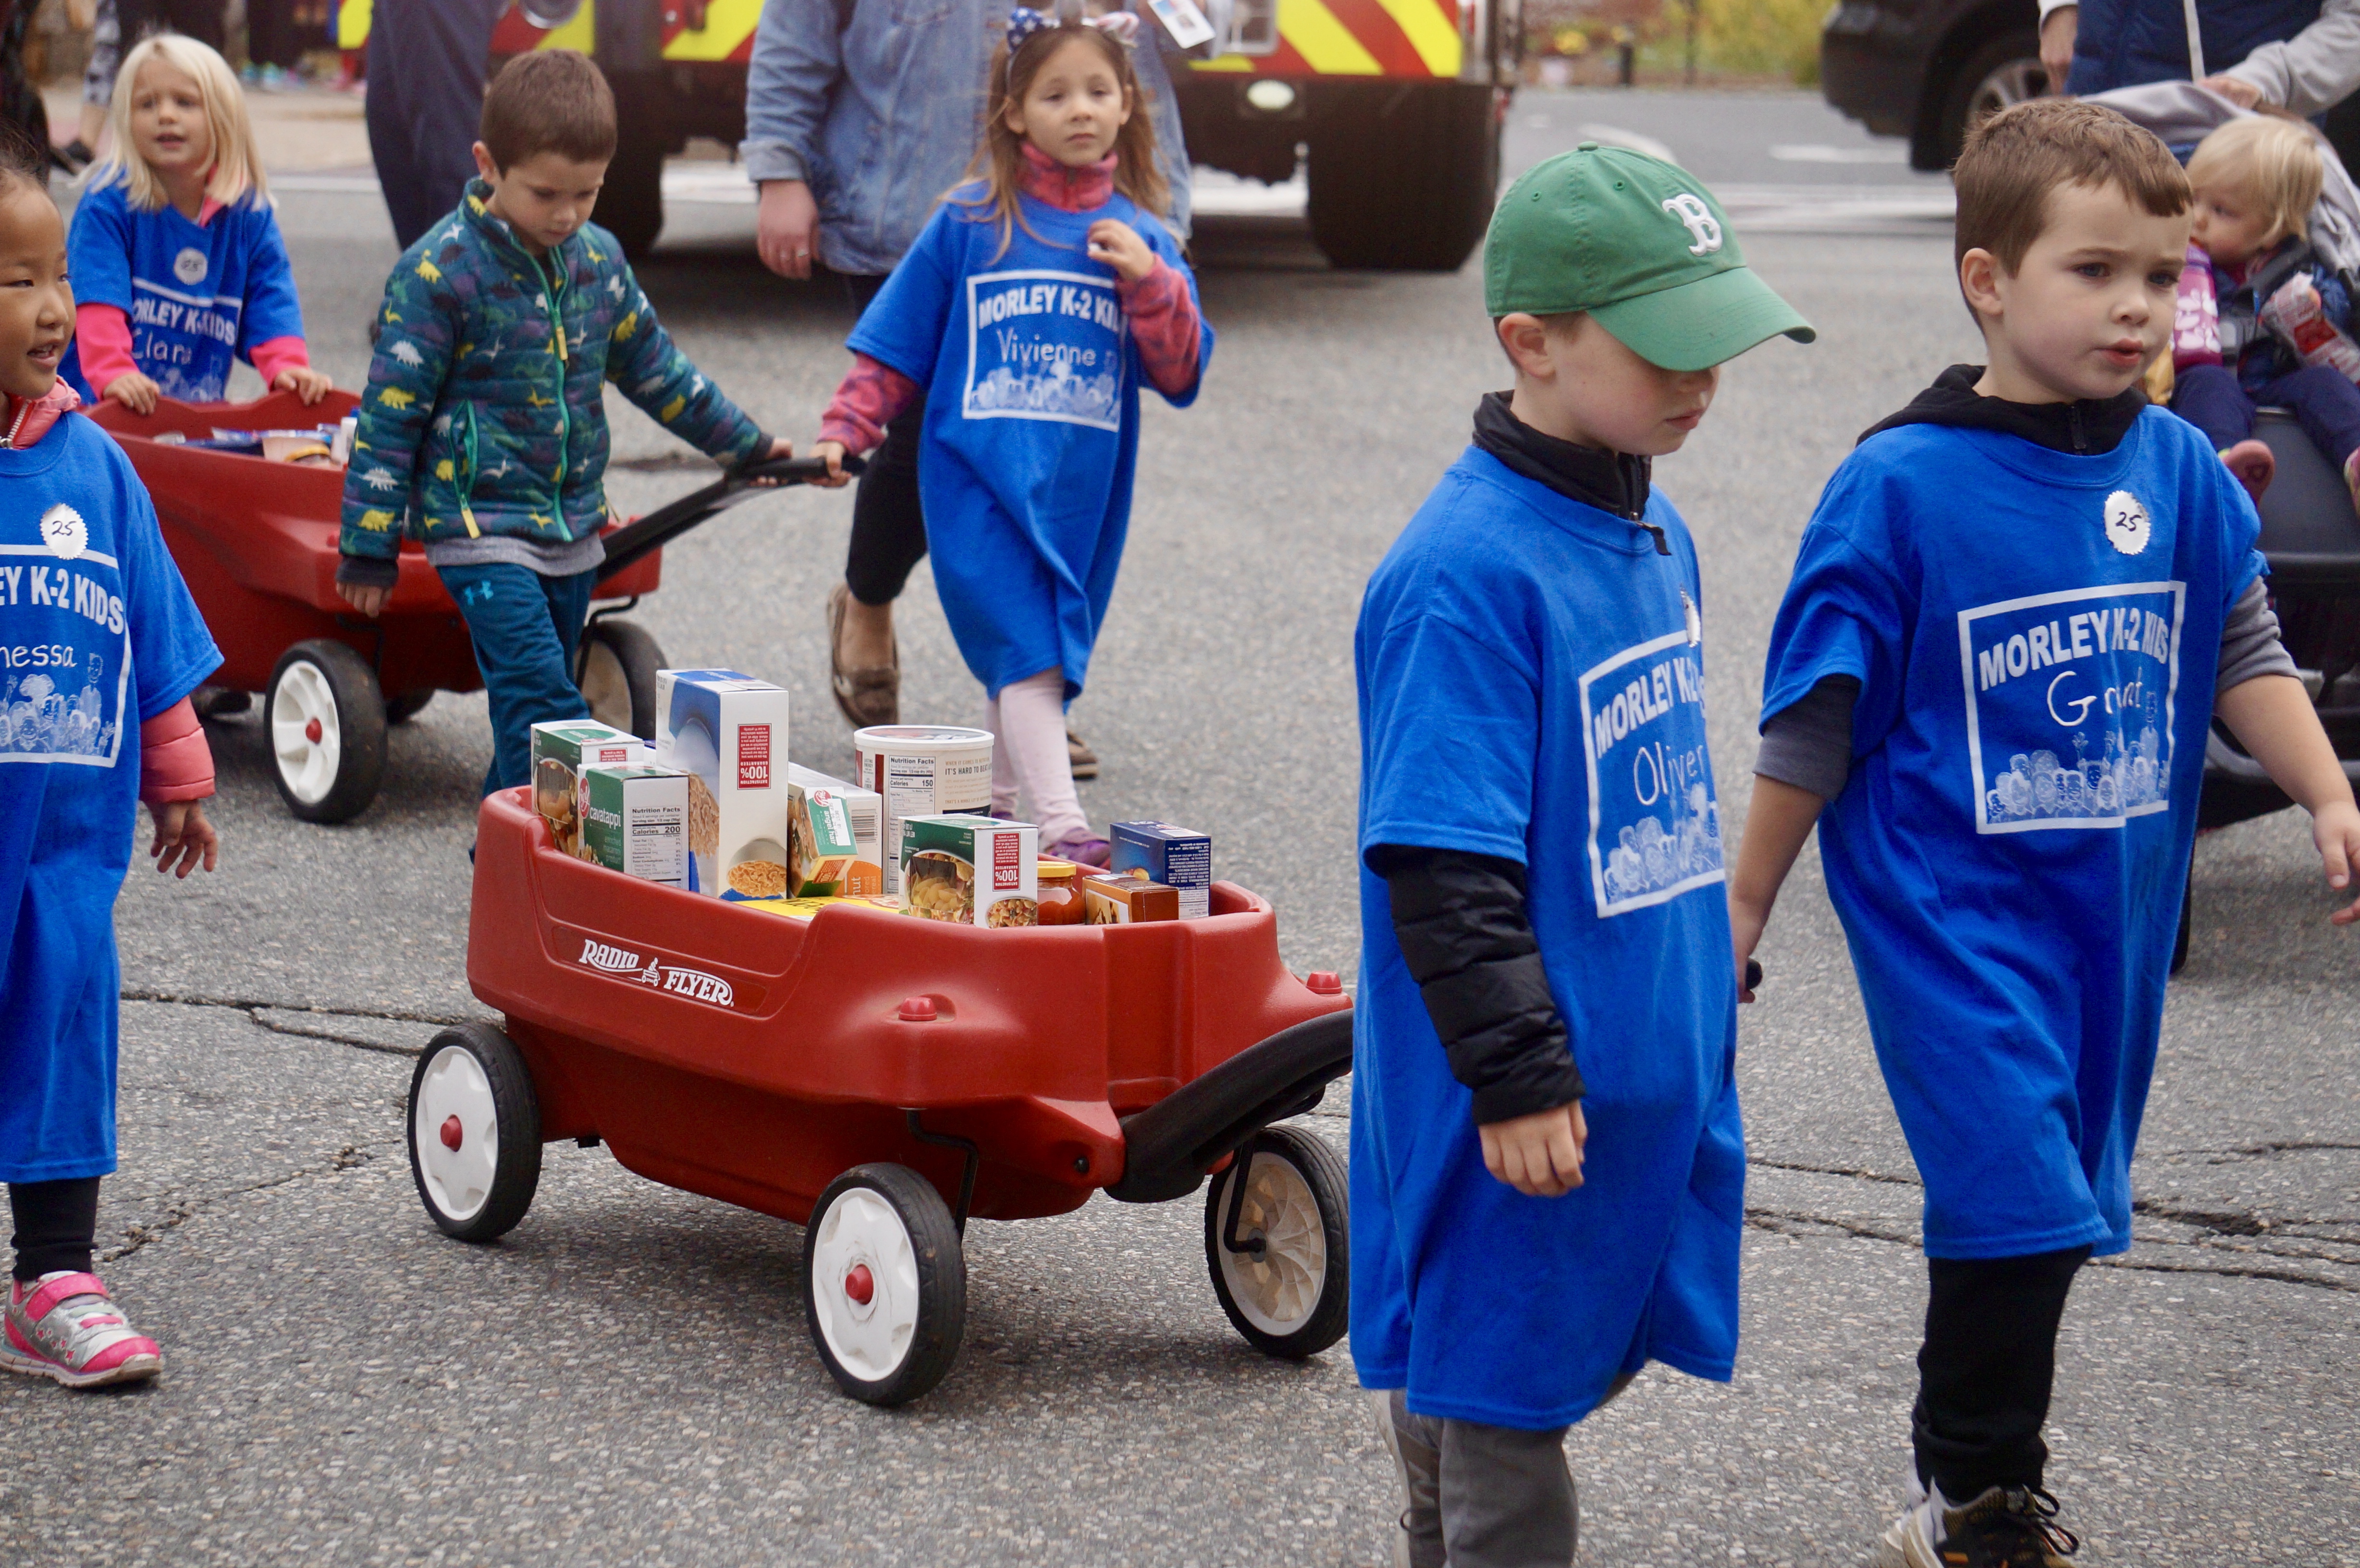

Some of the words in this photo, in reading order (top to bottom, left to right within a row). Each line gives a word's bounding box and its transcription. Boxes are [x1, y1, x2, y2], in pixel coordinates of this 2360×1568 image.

[1662, 194, 1724, 257] B
[132, 298, 184, 329] ORLEY
[978, 285, 1058, 330] MORLEY
[1060, 286, 1093, 319] K-2
[996, 328, 1096, 366] Vivienne
[52, 520, 76, 536] 25
[2115, 511, 2142, 532] 25
[30, 566, 70, 609] K-2
[74, 573, 124, 635] KIDS
[1979, 610, 2108, 691] MORLEY
[1594, 661, 1673, 759] MORLEY
[2047, 666, 2143, 726] Grnt
[741, 766, 768, 779] 100%
[1634, 741, 1706, 806] Oliver
[590, 807, 621, 830] cavatappi
[824, 811, 834, 830] angel
[996, 870, 1018, 881] 100%
[579, 939, 643, 972] RADIO
[661, 967, 733, 1006] FLYER
